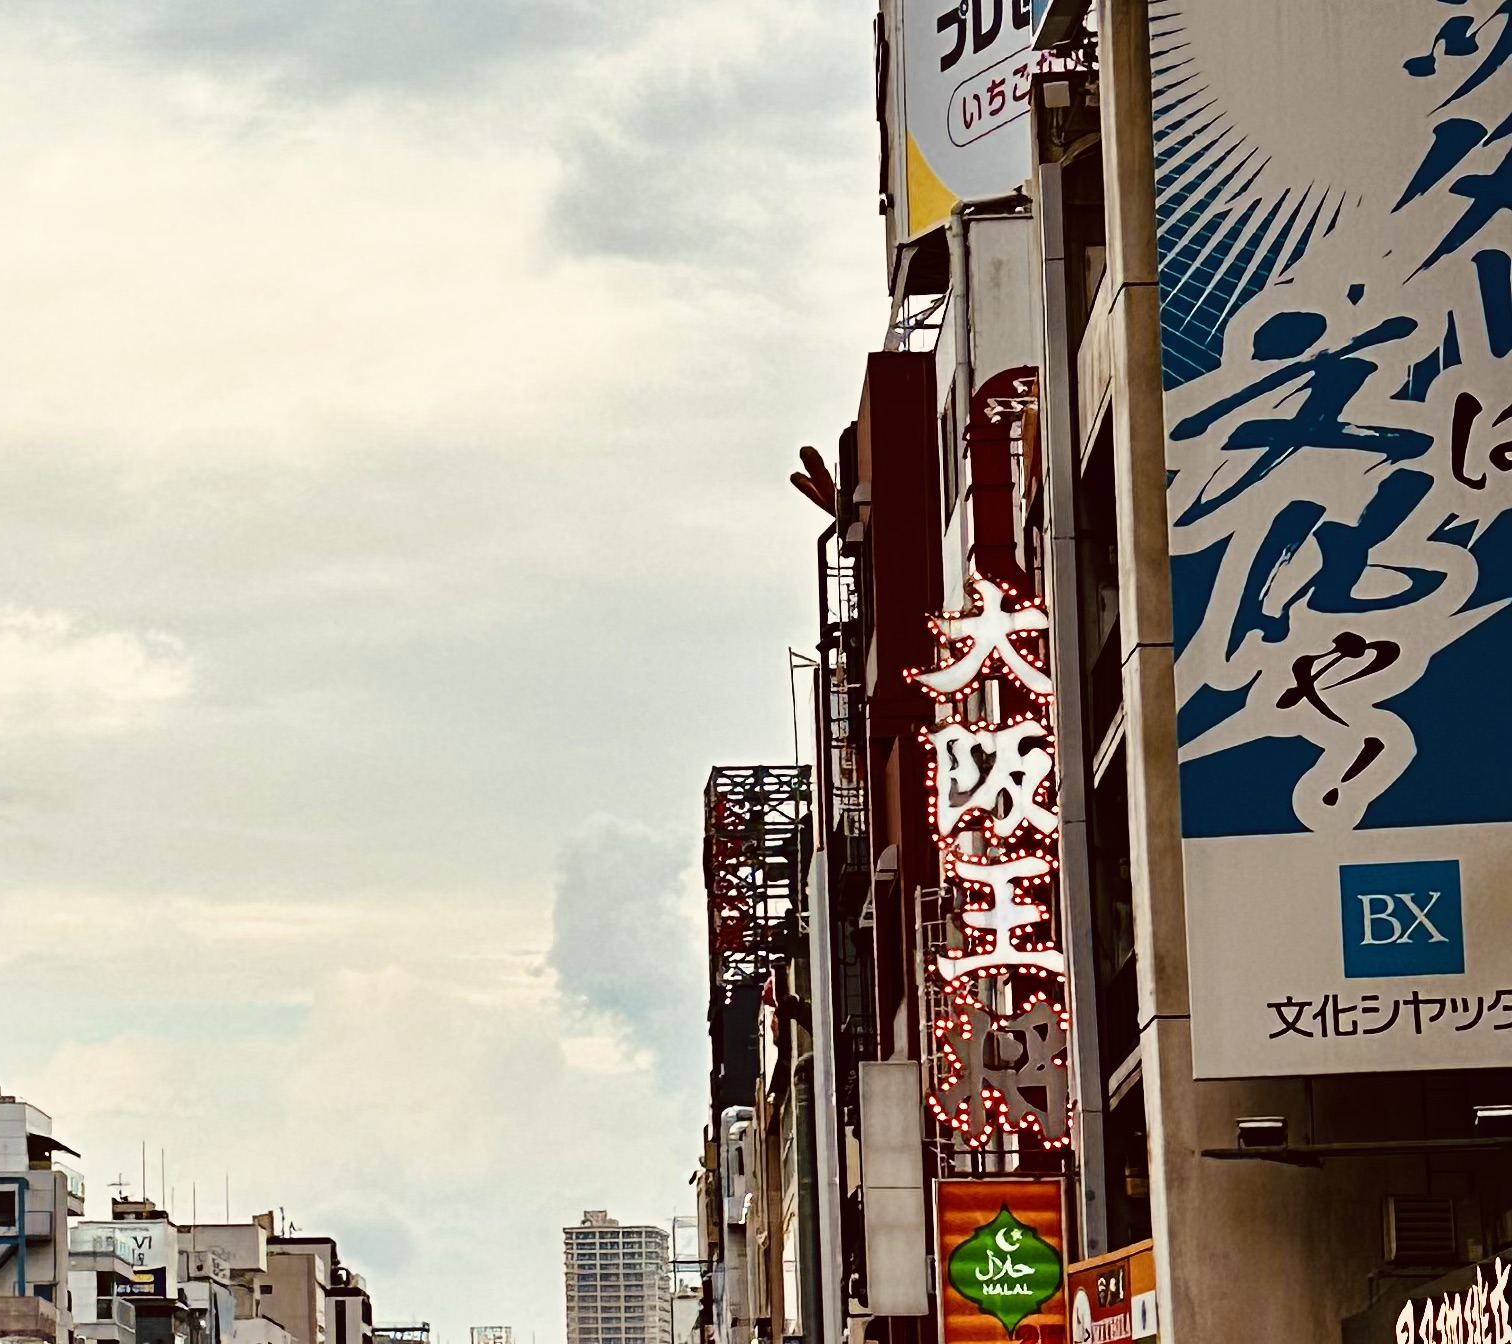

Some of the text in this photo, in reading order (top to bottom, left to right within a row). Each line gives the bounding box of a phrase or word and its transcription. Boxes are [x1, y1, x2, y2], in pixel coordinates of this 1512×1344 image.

[904, 574, 1070, 1146] 大阪王将
[1357, 891, 1449, 946] BX
[982, 1282, 1034, 1296] HALAL
